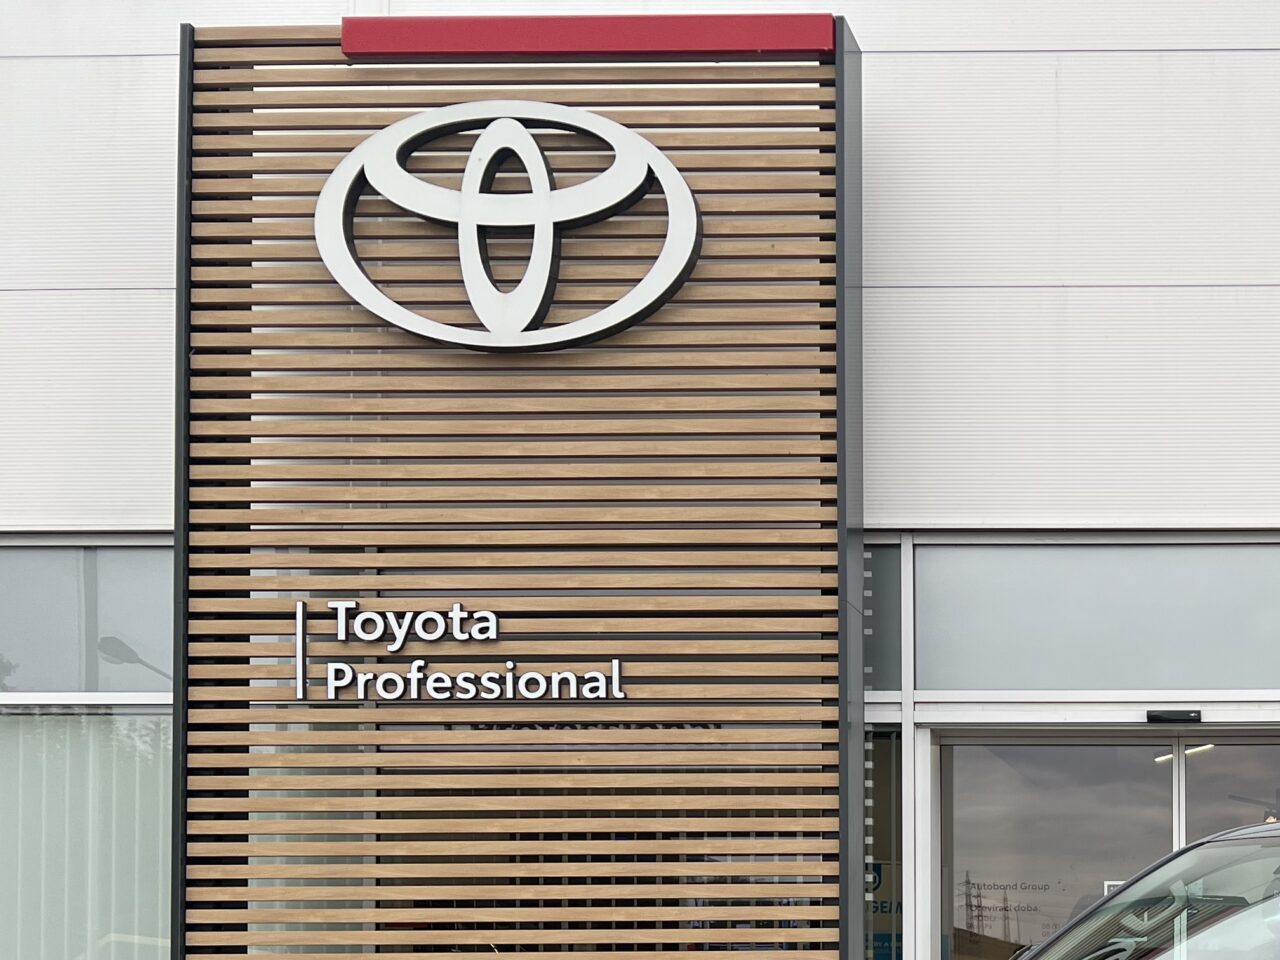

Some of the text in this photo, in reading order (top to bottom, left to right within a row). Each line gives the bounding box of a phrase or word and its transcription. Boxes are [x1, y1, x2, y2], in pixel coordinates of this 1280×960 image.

[327, 600, 498, 652] Toyota
[327, 659, 625, 700] Professional
[970, 882, 1050, 892] Autobond Group
